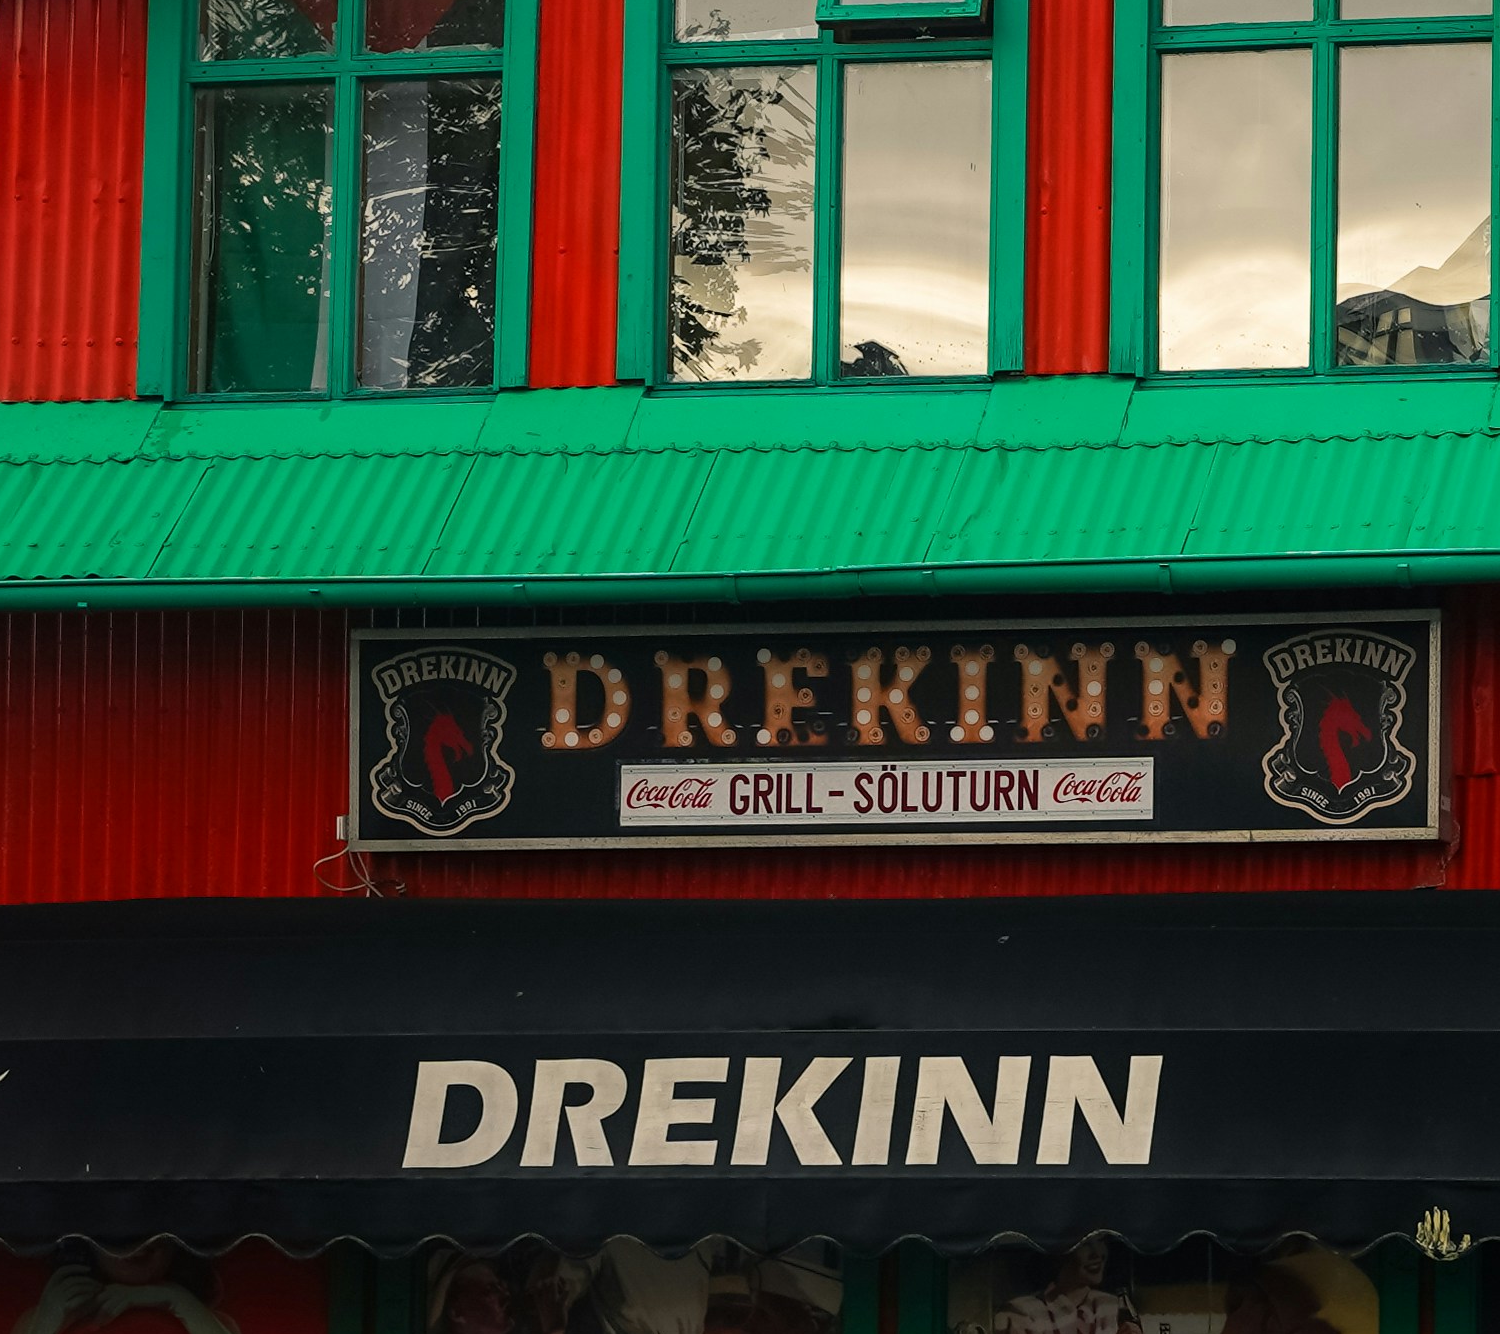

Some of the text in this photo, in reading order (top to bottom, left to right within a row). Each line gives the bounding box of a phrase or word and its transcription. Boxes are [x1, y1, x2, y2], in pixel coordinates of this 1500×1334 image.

[380, 656, 509, 697] DREKINN
[1274, 642, 1405, 678] DREKINN
[540, 640, 1237, 751] DREKINN
[406, 799, 478, 821] SINCE 1991
[626, 778, 718, 810] Coca-Cola
[1052, 772, 1146, 805] Coca-Cola
[1301, 785, 1377, 809] SINCE 1991
[402, 1055, 1163, 1168] DREKINN
